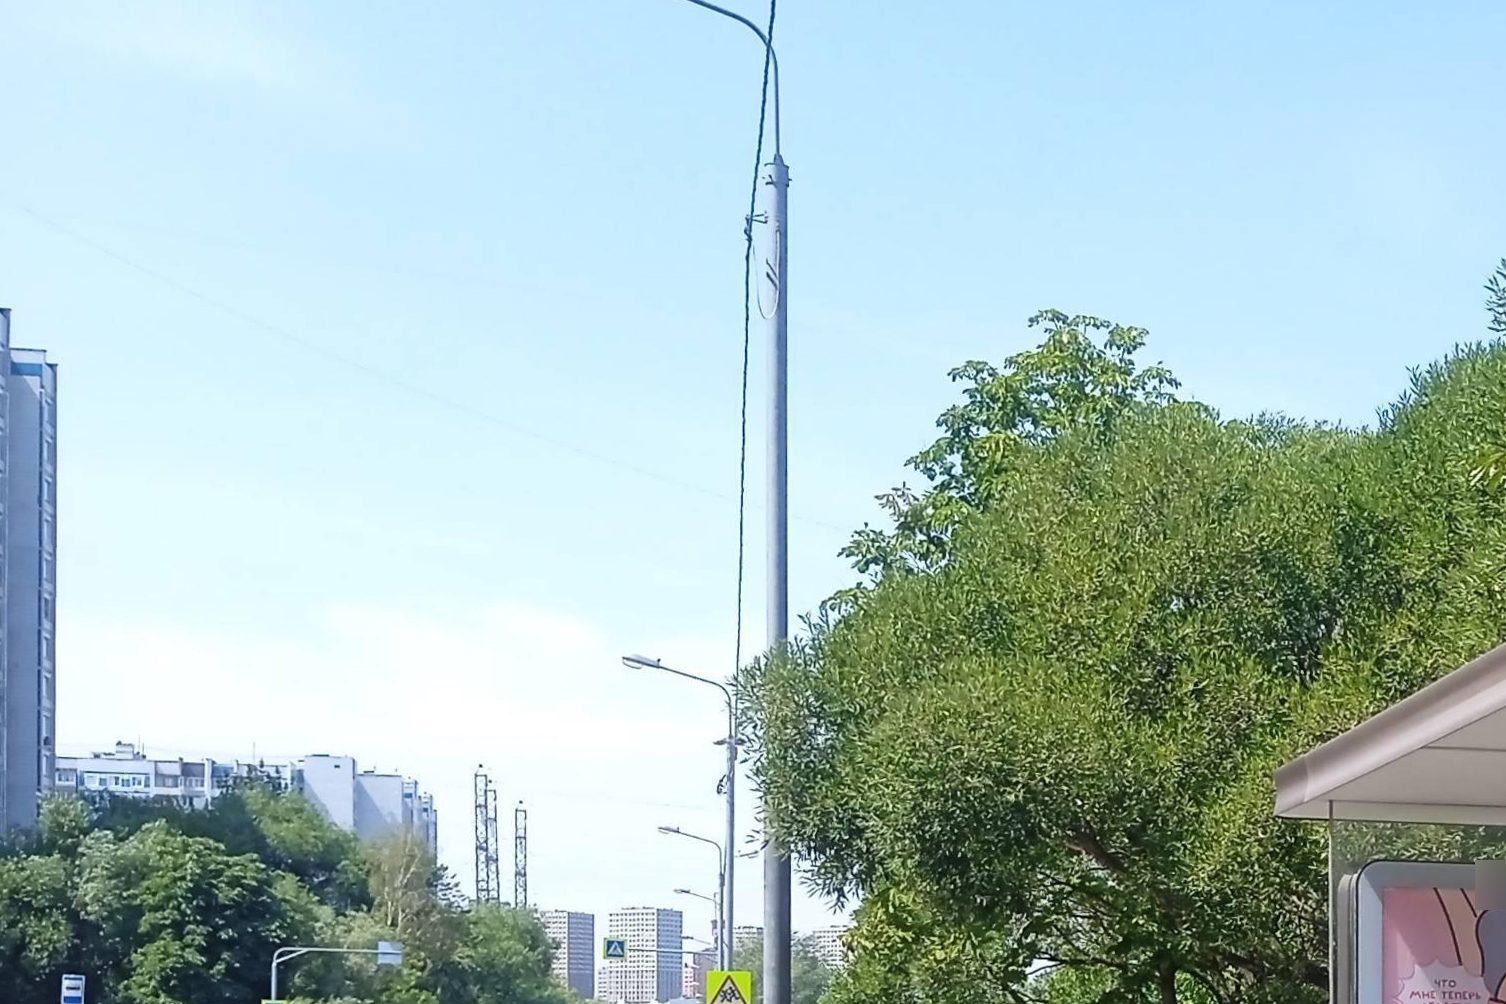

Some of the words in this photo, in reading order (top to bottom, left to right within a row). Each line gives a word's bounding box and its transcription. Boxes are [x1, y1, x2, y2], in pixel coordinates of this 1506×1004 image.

[1434, 979, 1457, 989] ЧТО
[1409, 990, 1437, 1000] МНЕ
[1442, 990, 1482, 1001] ТЕПЕРЬ
